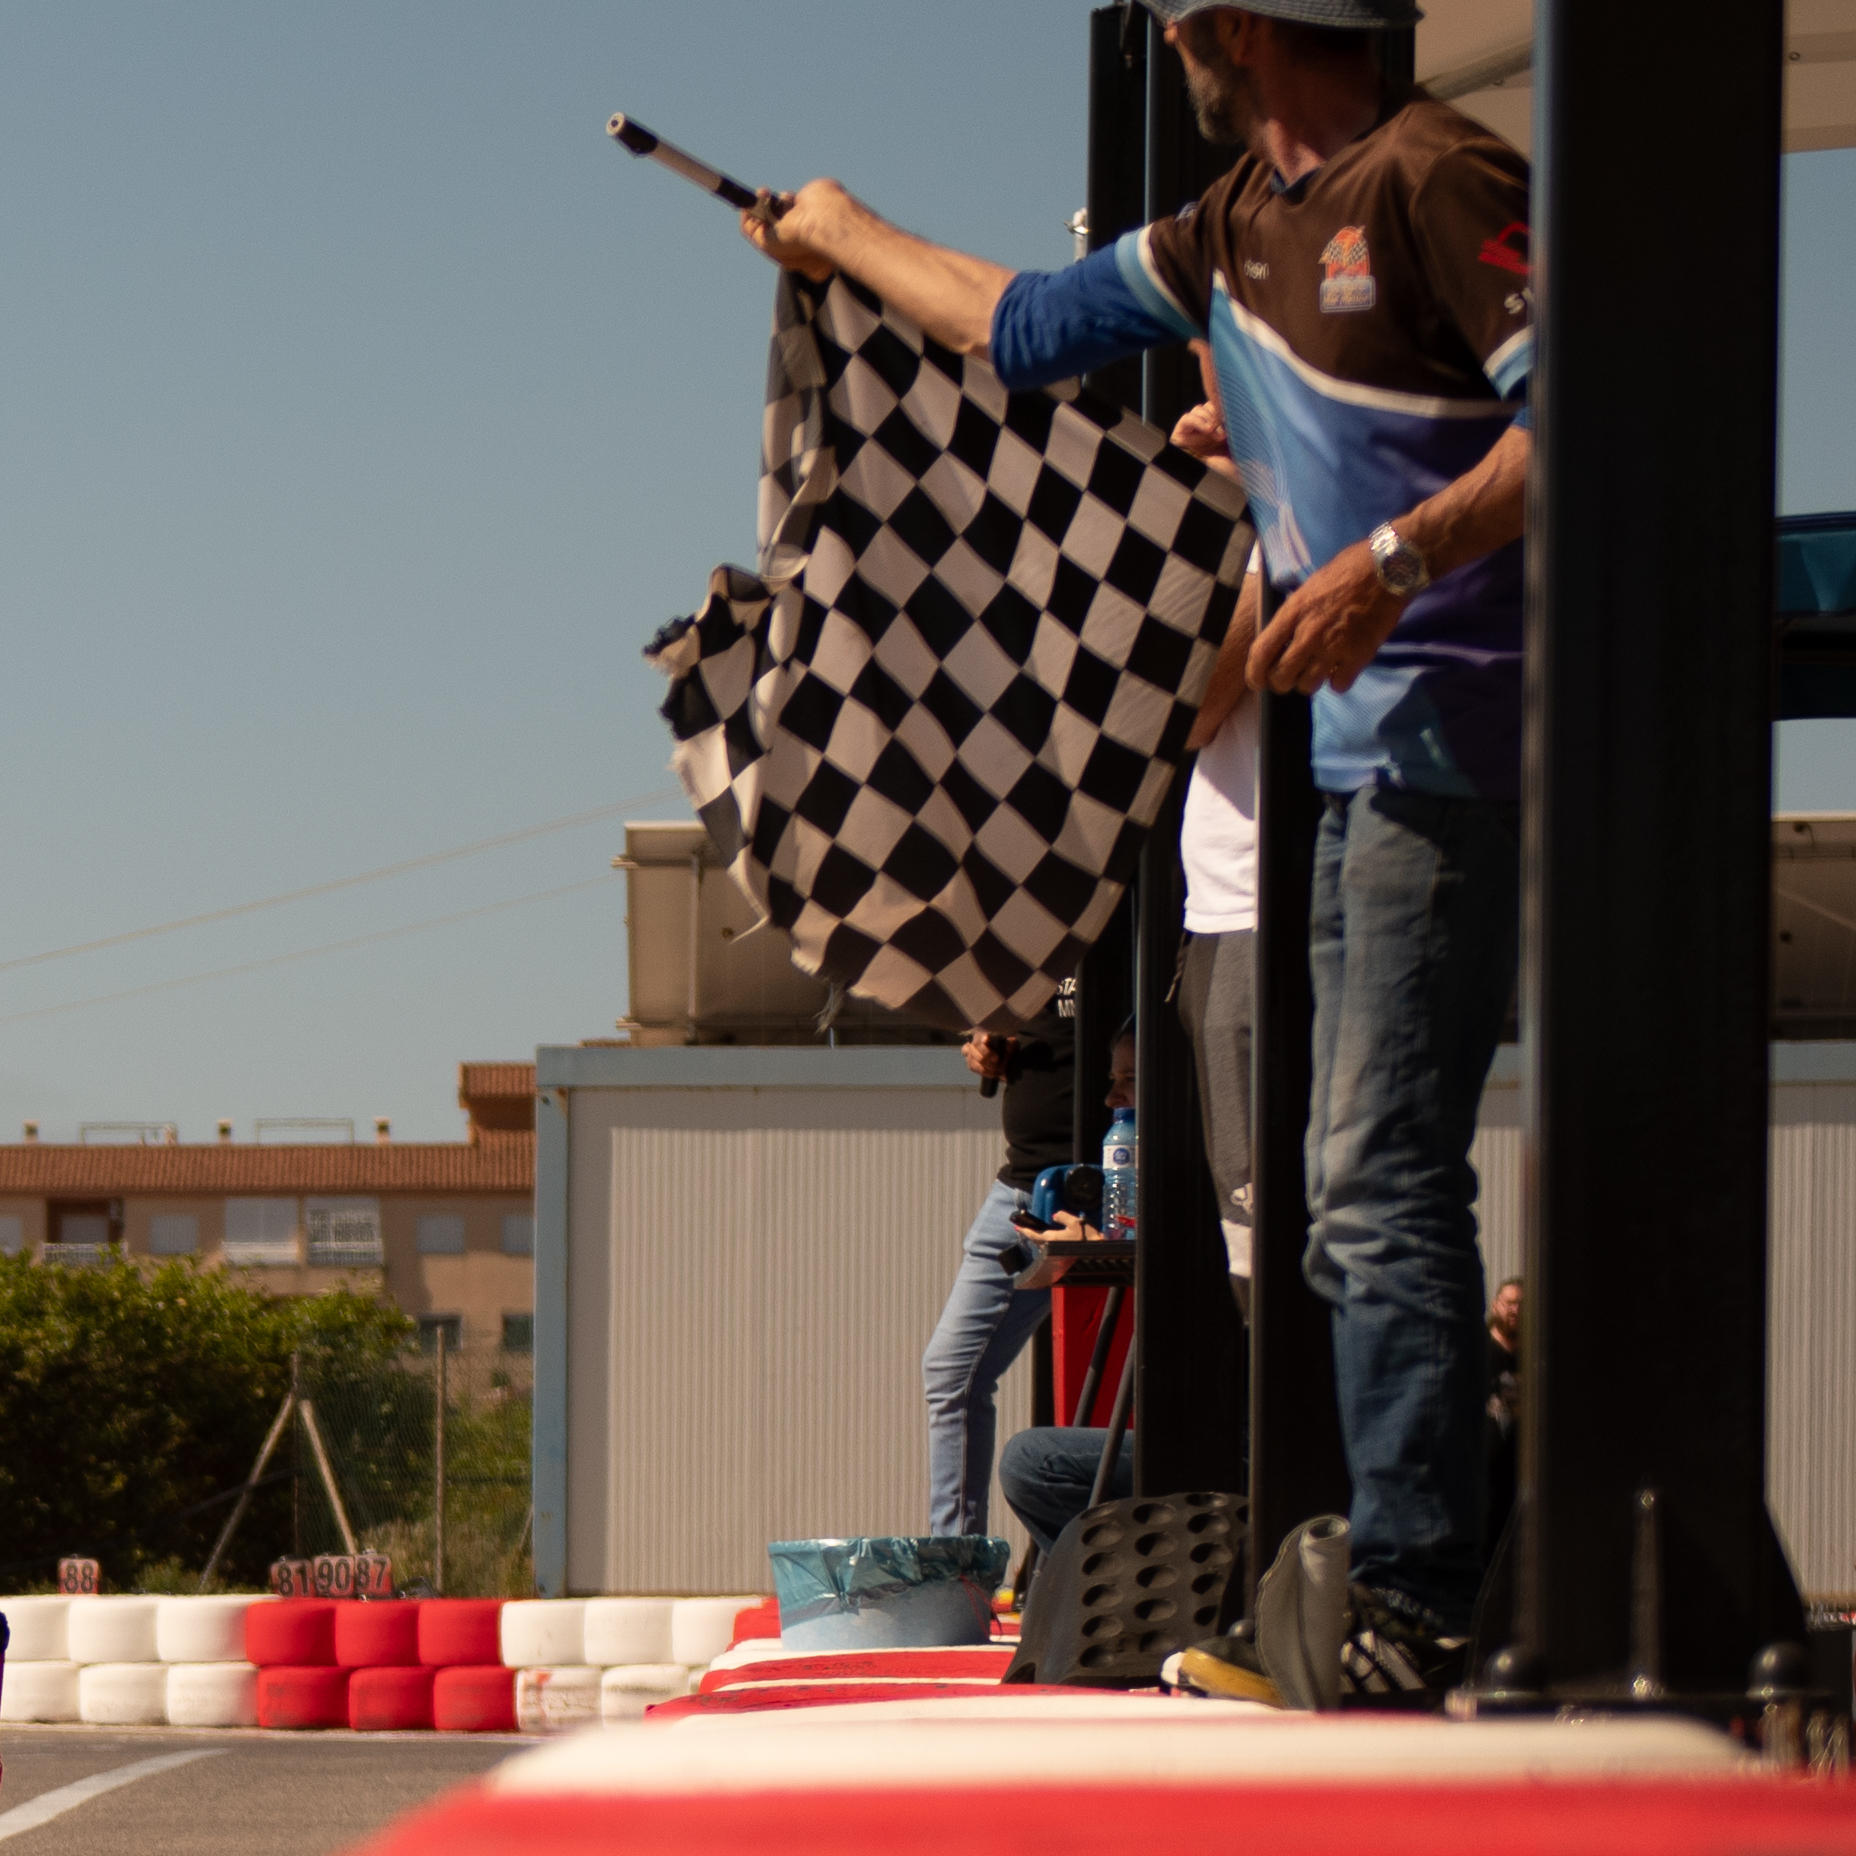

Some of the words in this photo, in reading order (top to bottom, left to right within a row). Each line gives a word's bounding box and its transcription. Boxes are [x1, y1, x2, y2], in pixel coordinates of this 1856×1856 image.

[64, 1562, 94, 1594] 88
[276, 1562, 311, 1597] 81
[316, 1559, 351, 1594] 90
[356, 1557, 387, 1591] 87
